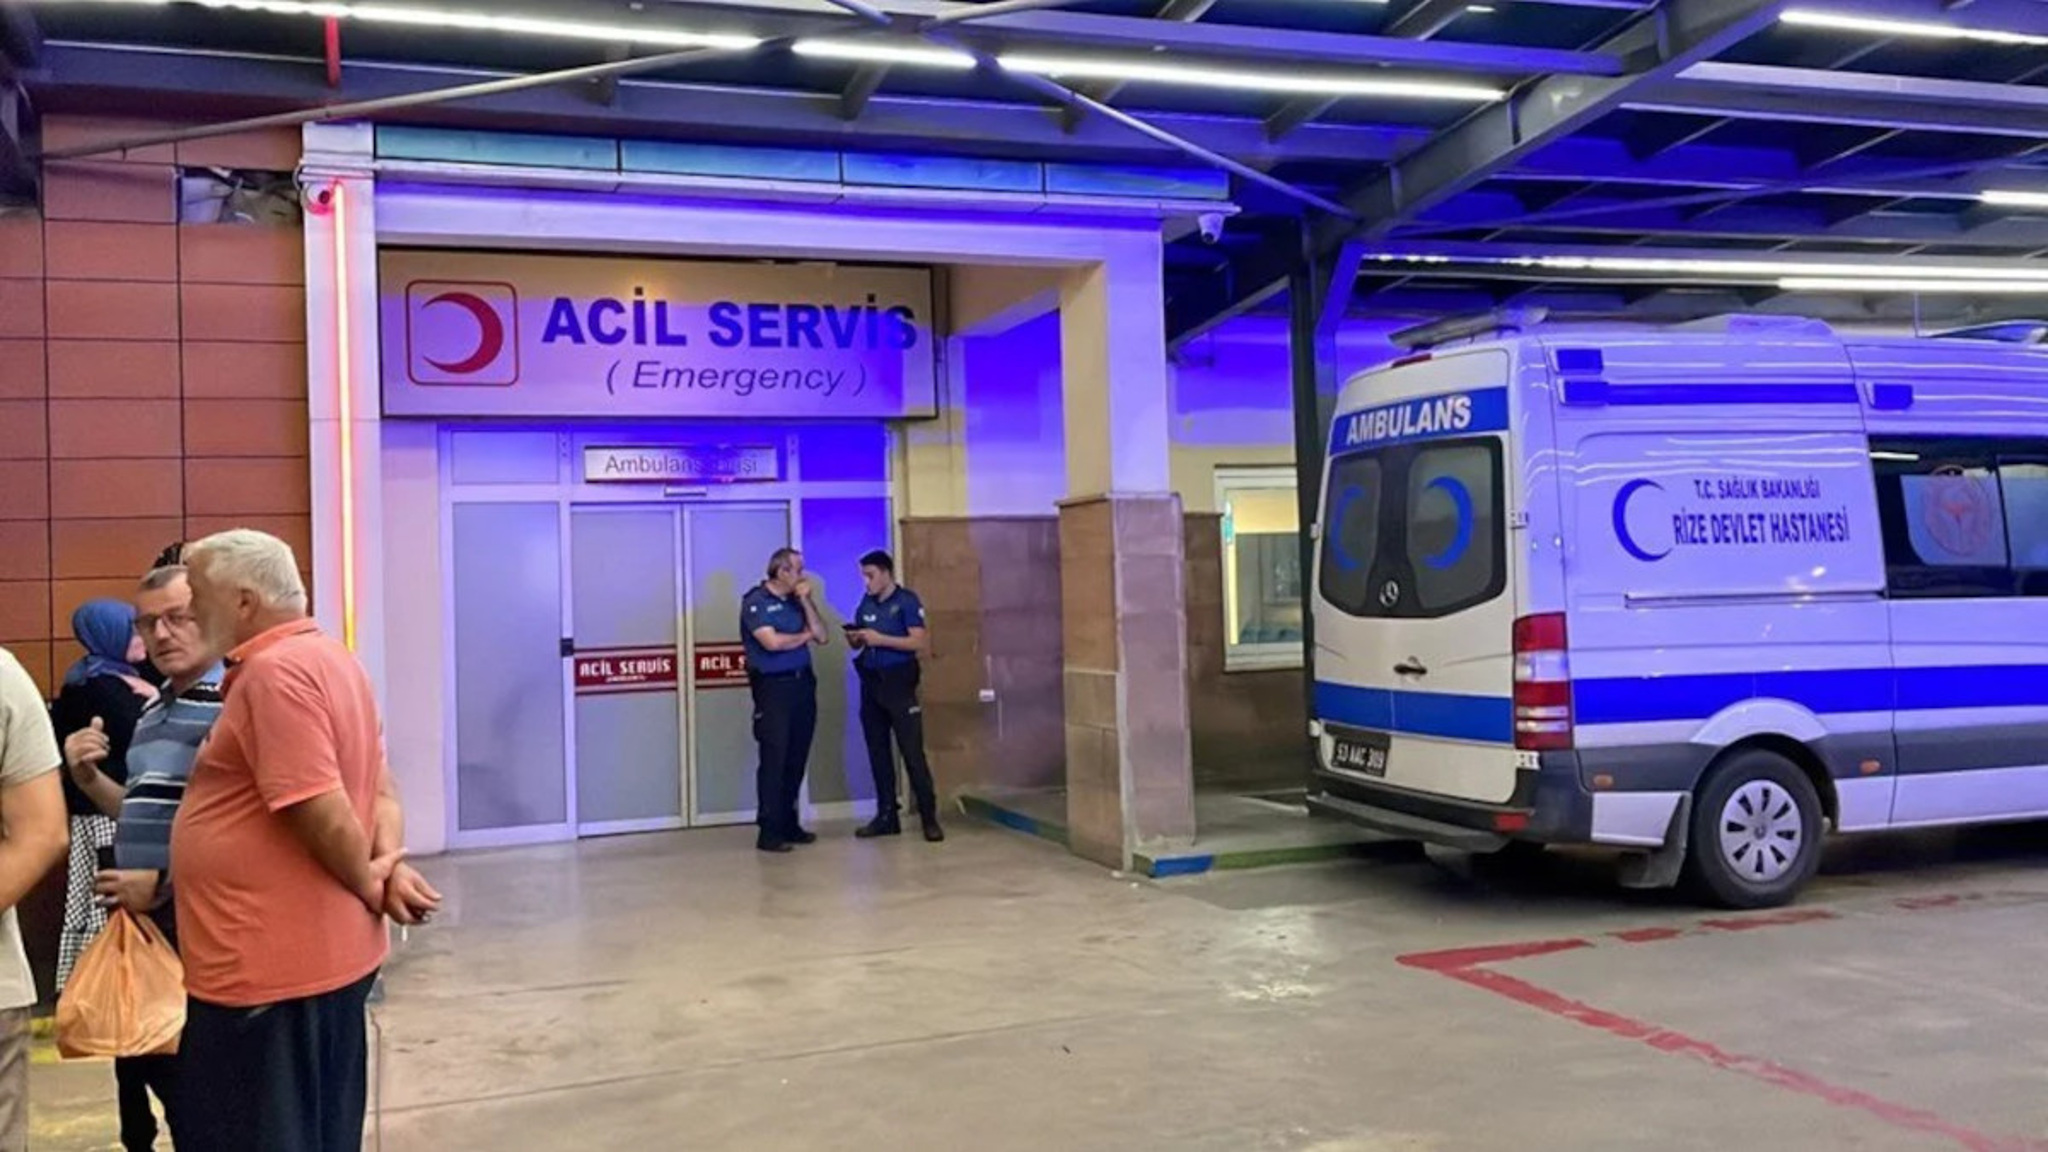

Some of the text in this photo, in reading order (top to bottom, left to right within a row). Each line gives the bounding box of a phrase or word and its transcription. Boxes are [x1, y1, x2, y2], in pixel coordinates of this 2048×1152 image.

[541, 286, 919, 350] ACİL SERVİS
[1346, 395, 1473, 445] AMBULANS
[1693, 475, 1821, 500] T.C. SAĞLIK BAKANLIĞI
[1672, 504, 1850, 545] RİZE DEVLET HASTANESİ
[579, 656, 672, 678] ACİL SERVİS
[700, 654, 732, 671] ACİL
